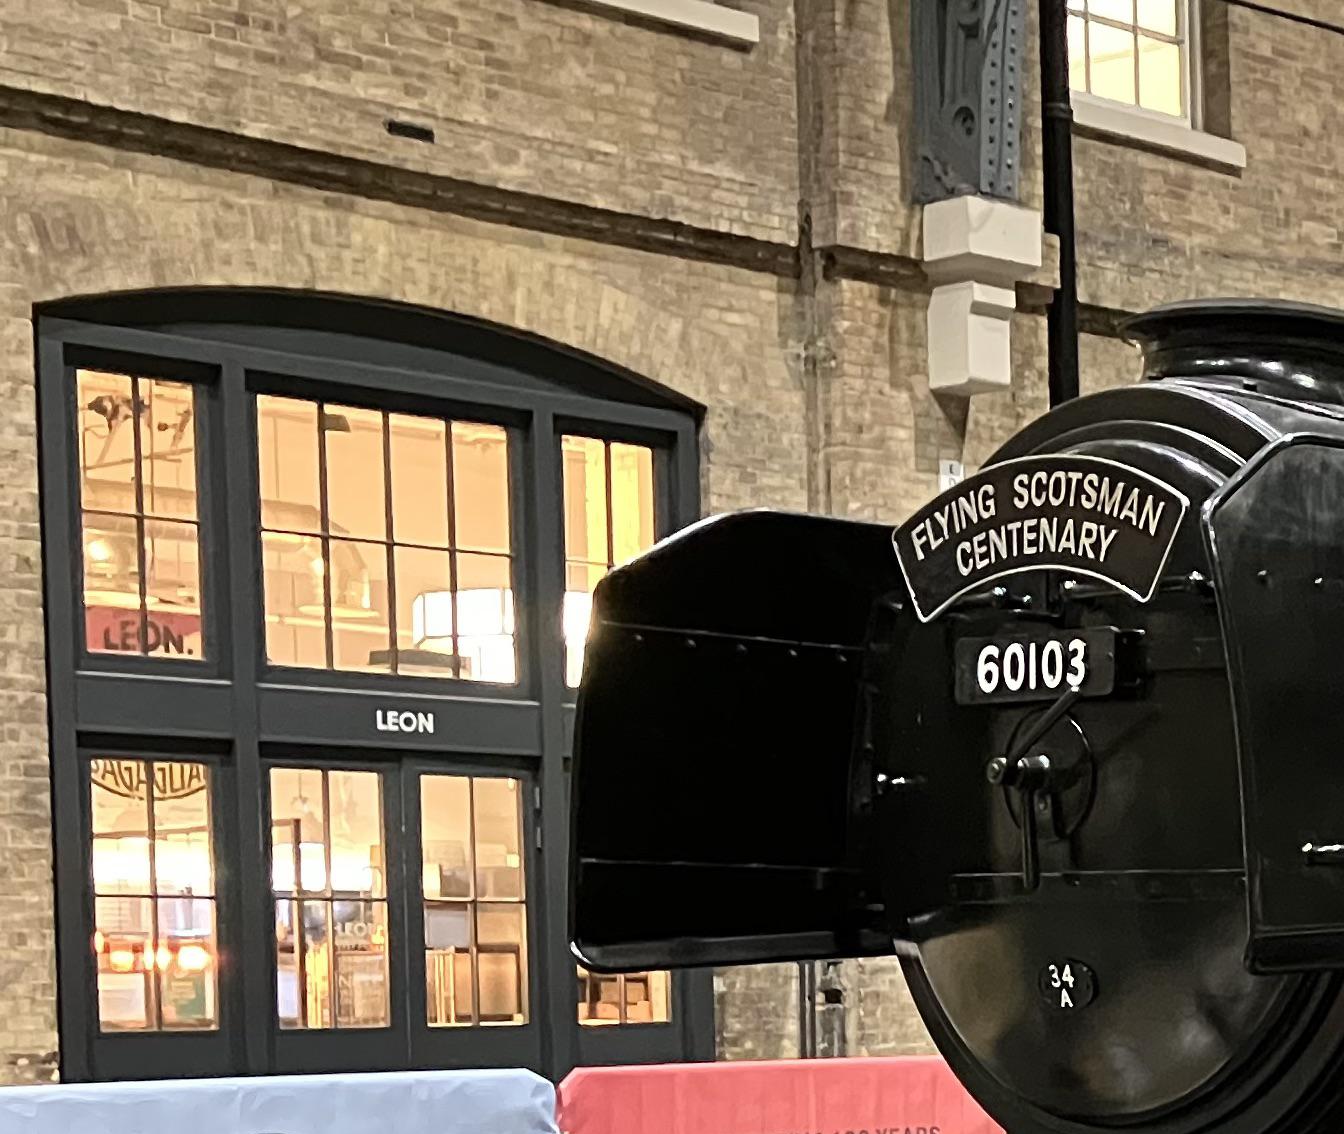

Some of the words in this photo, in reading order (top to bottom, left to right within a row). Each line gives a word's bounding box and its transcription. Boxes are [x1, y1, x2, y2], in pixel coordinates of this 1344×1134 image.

[910, 484, 996, 561] FLYING
[1013, 470, 1165, 536] SCOTSMAN
[956, 518, 1117, 577] CENTENARY
[977, 638, 1086, 693] 60103
[376, 709, 434, 734] LEON
[1060, 988, 1074, 1008] A
